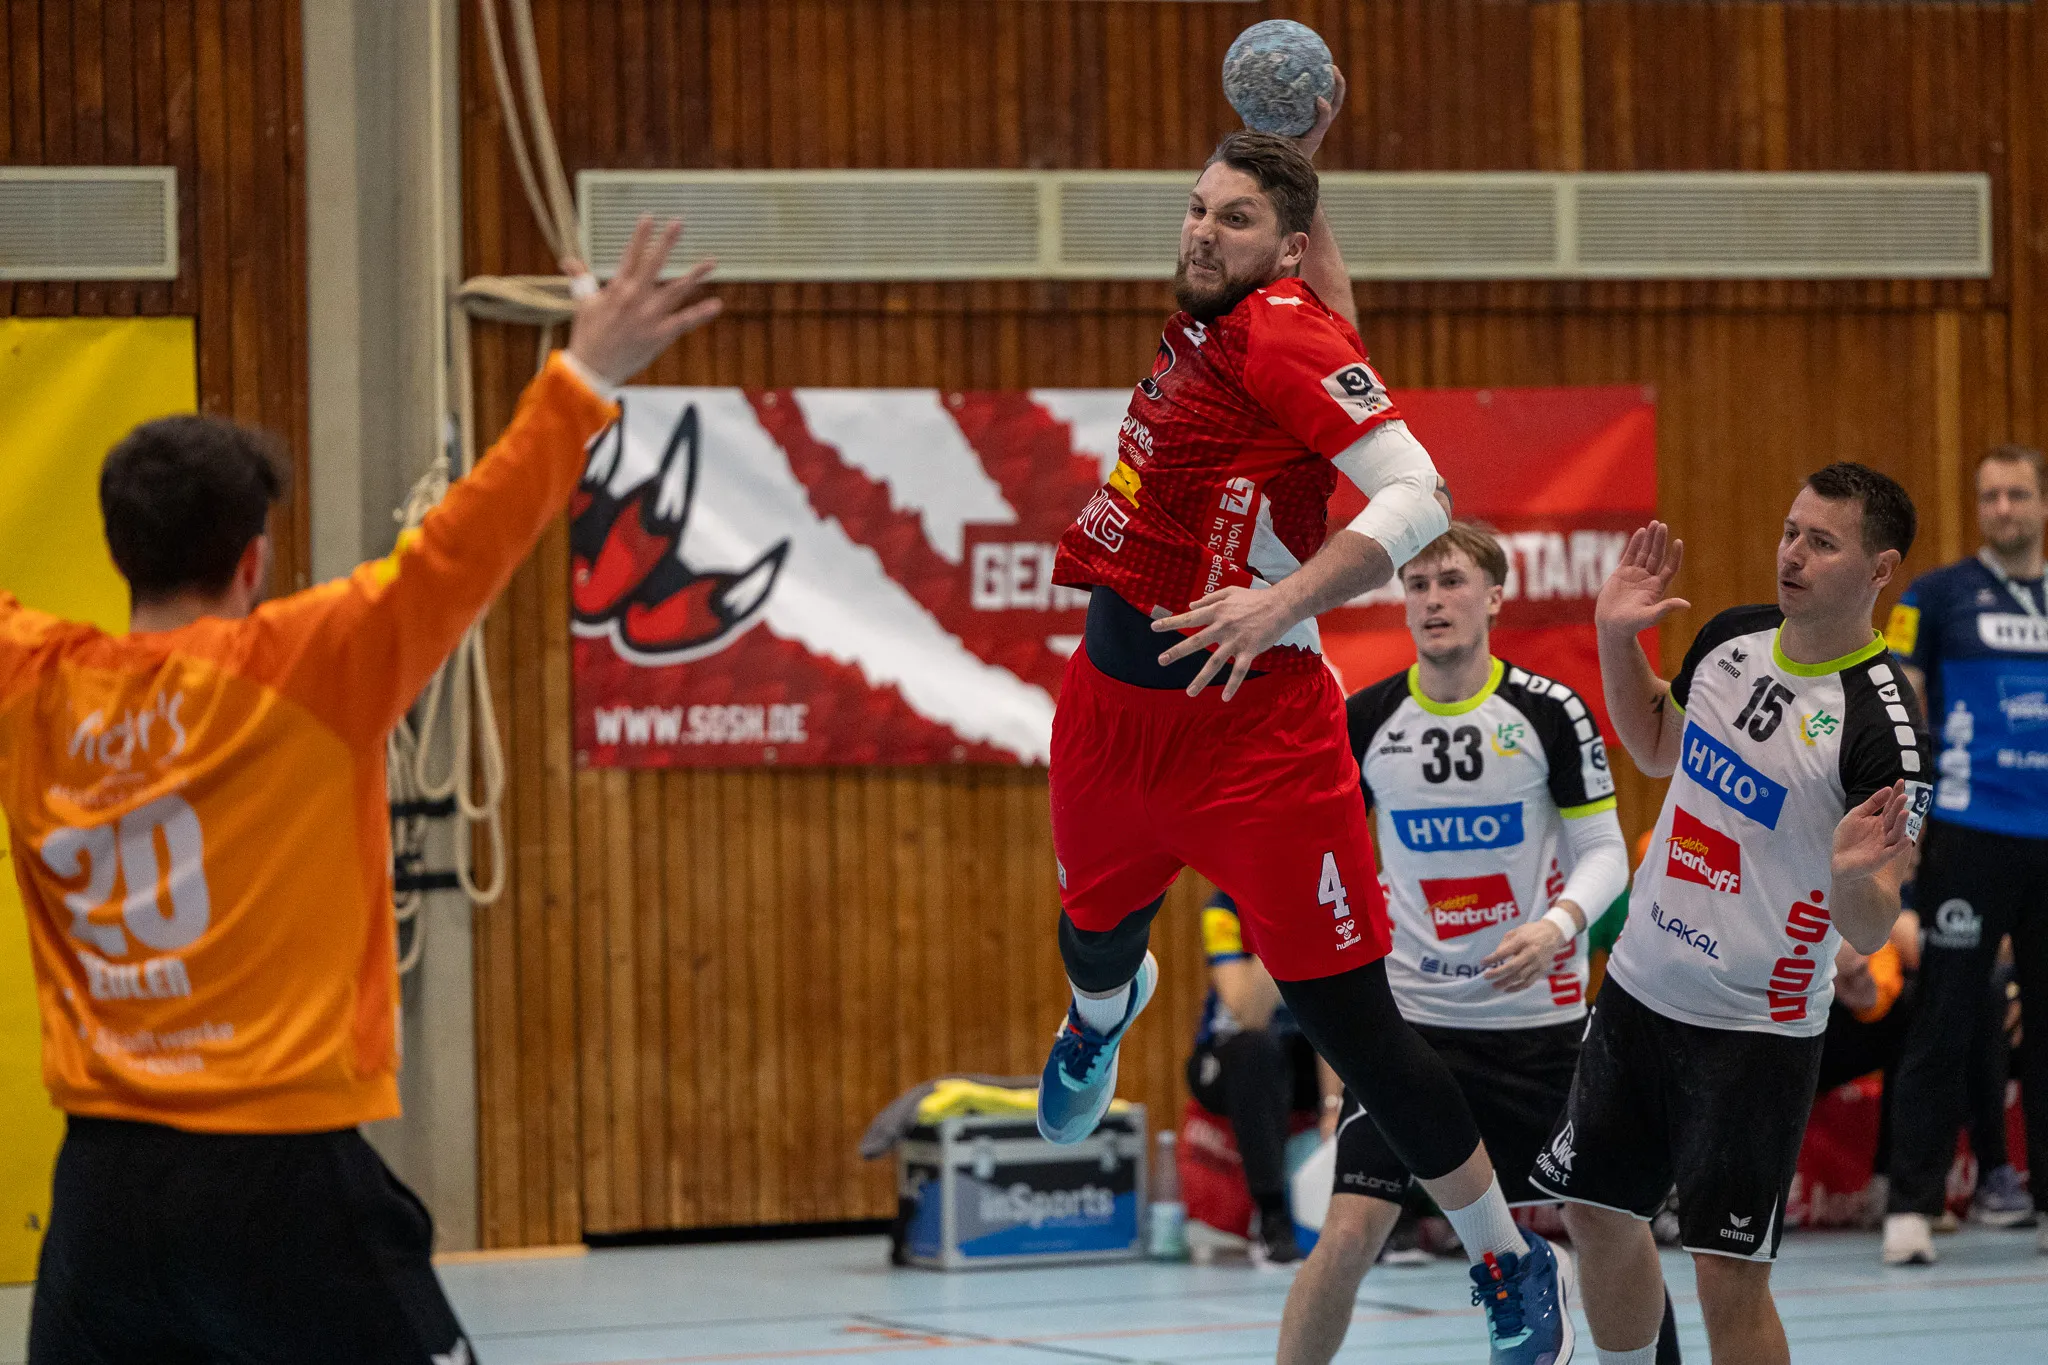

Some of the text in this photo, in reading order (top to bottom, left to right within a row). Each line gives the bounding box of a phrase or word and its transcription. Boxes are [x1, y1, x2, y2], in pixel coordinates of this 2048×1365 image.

[1732, 675, 1796, 742] 15
[1421, 725, 1484, 784] 33
[41, 794, 210, 956] 20
[1318, 851, 1351, 920] 4
[1435, 900, 1515, 925] bartruff
[1657, 910, 1719, 960] LAKAL
[1336, 933, 1361, 951] hummel
[1720, 1228, 1755, 1243] erima
